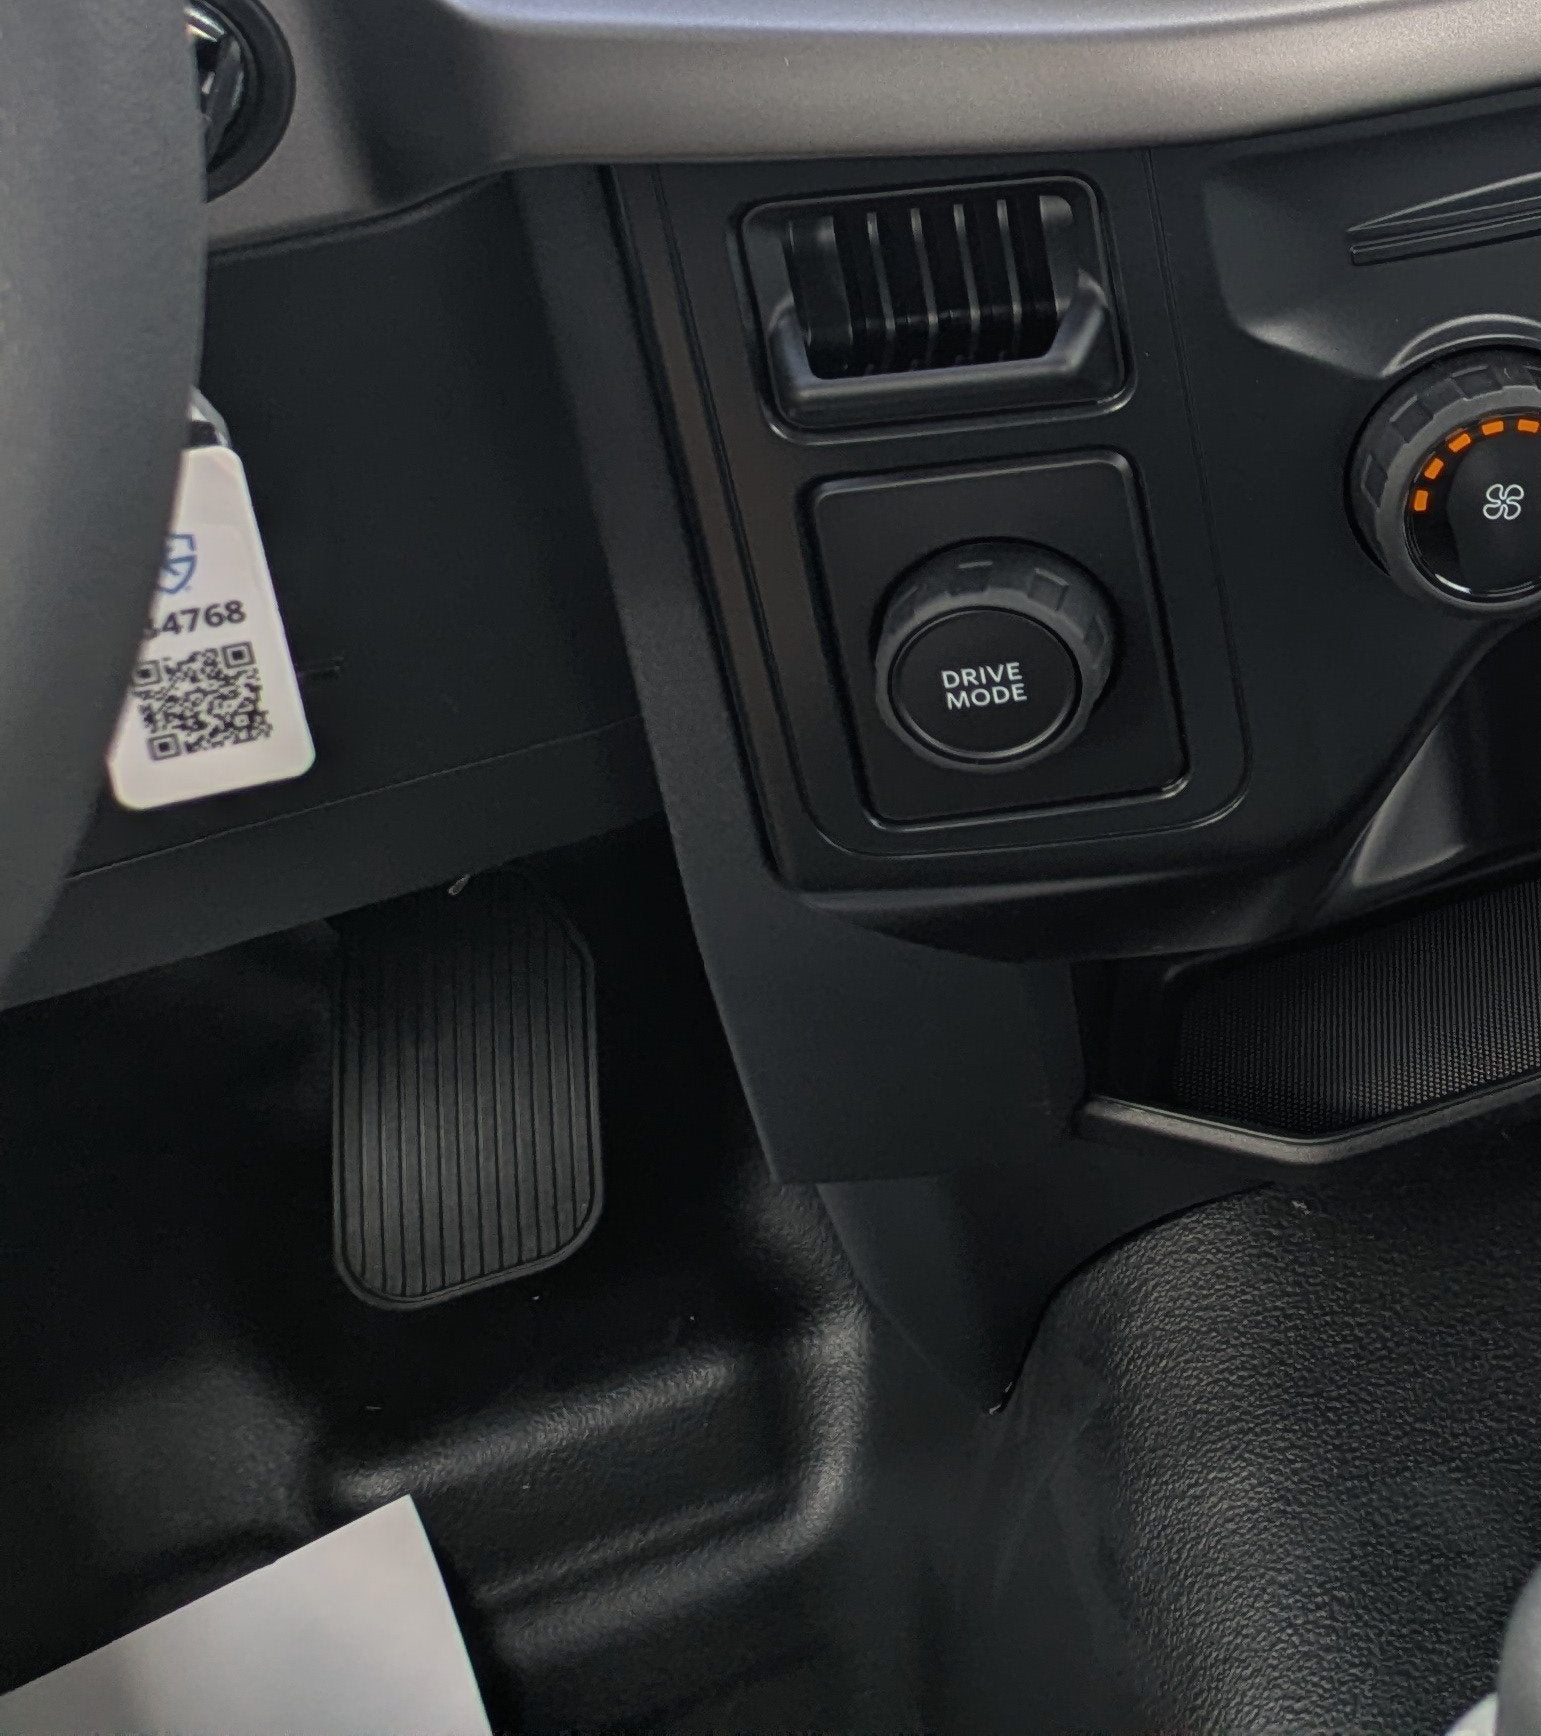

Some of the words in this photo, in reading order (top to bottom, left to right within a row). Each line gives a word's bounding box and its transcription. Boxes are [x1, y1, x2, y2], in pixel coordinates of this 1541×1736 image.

[150, 599, 247, 639] 4768
[941, 662, 1023, 690] DRIVE
[946, 681, 1028, 711] MODE
